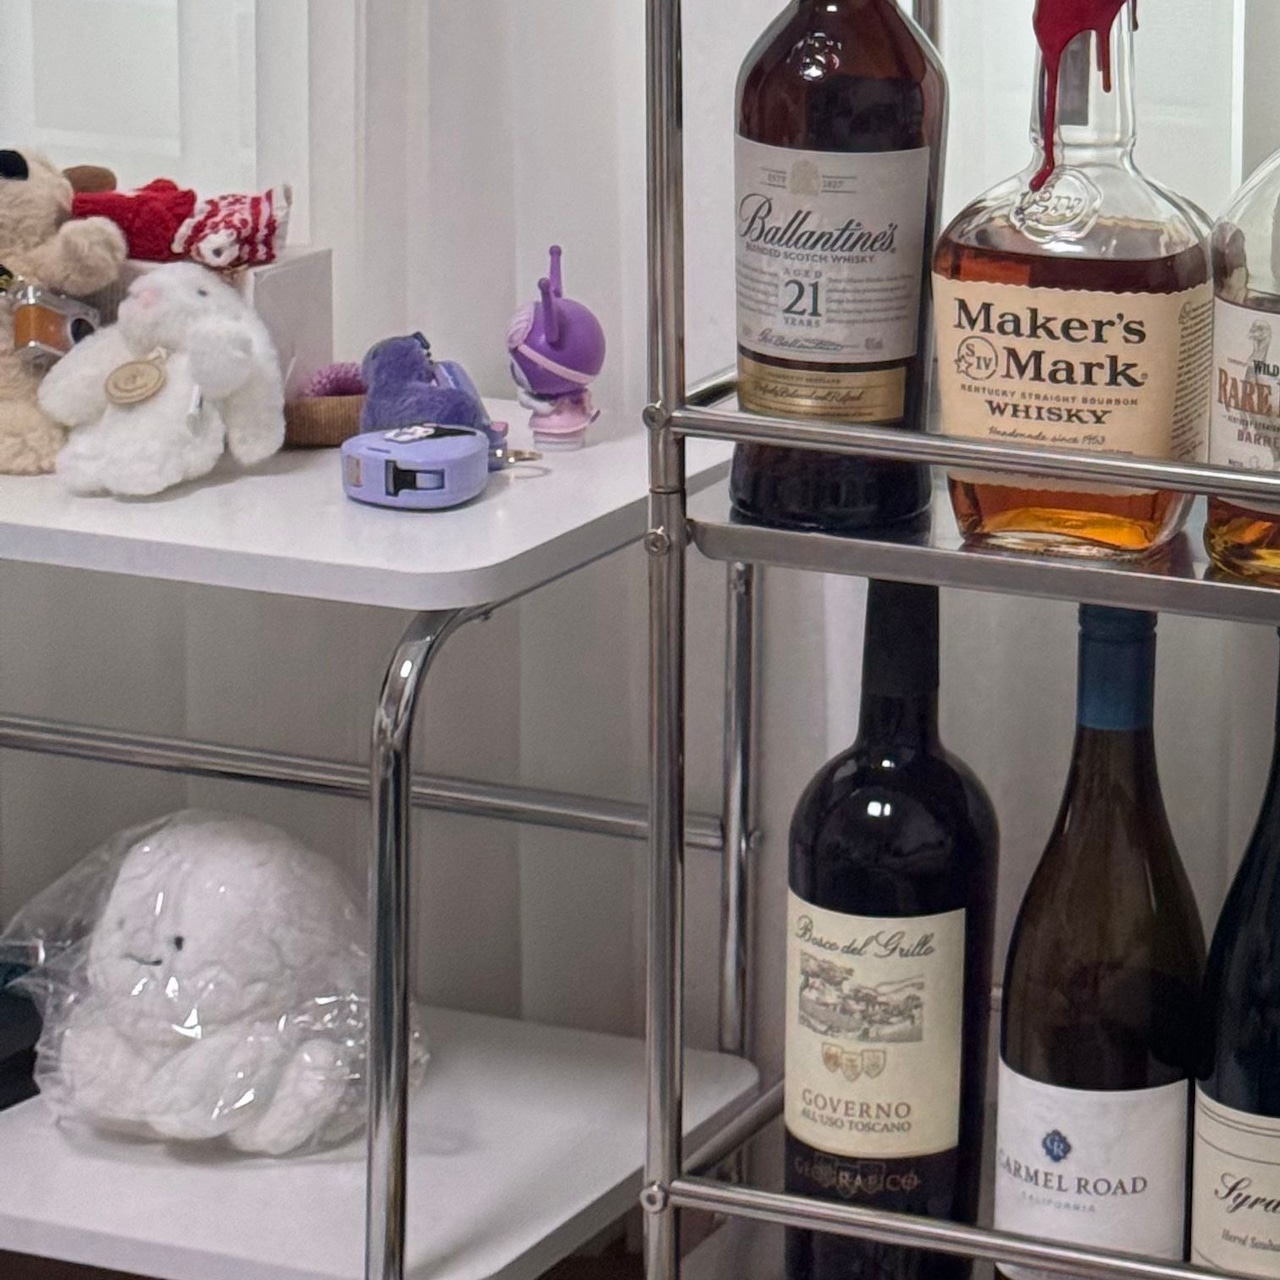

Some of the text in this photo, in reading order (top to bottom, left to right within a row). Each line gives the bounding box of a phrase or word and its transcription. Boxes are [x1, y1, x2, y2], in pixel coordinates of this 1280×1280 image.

[739, 192, 899, 253] Ballantine's
[782, 250, 828, 263] SCOTCH
[831, 254, 875, 264] WHISKY
[783, 279, 822, 317] 21
[783, 317, 821, 328] YEARS
[953, 296, 1147, 345] Maker's
[1000, 346, 1146, 389] Mark
[1252, 359, 1280, 378] WILD
[960, 383, 1138, 407] KENTUCKY STRAIGHT BOURBON
[1217, 366, 1273, 418] RARE
[984, 399, 1112, 426] WHISKY
[988, 425, 1048, 443] Handmade
[1050, 433, 1079, 445] since
[840, 934, 876, 957] del
[802, 1088, 912, 1119] GOVERNO
[847, 1119, 912, 1133] TOSCANO
[1076, 1175, 1148, 1196] ROAD
